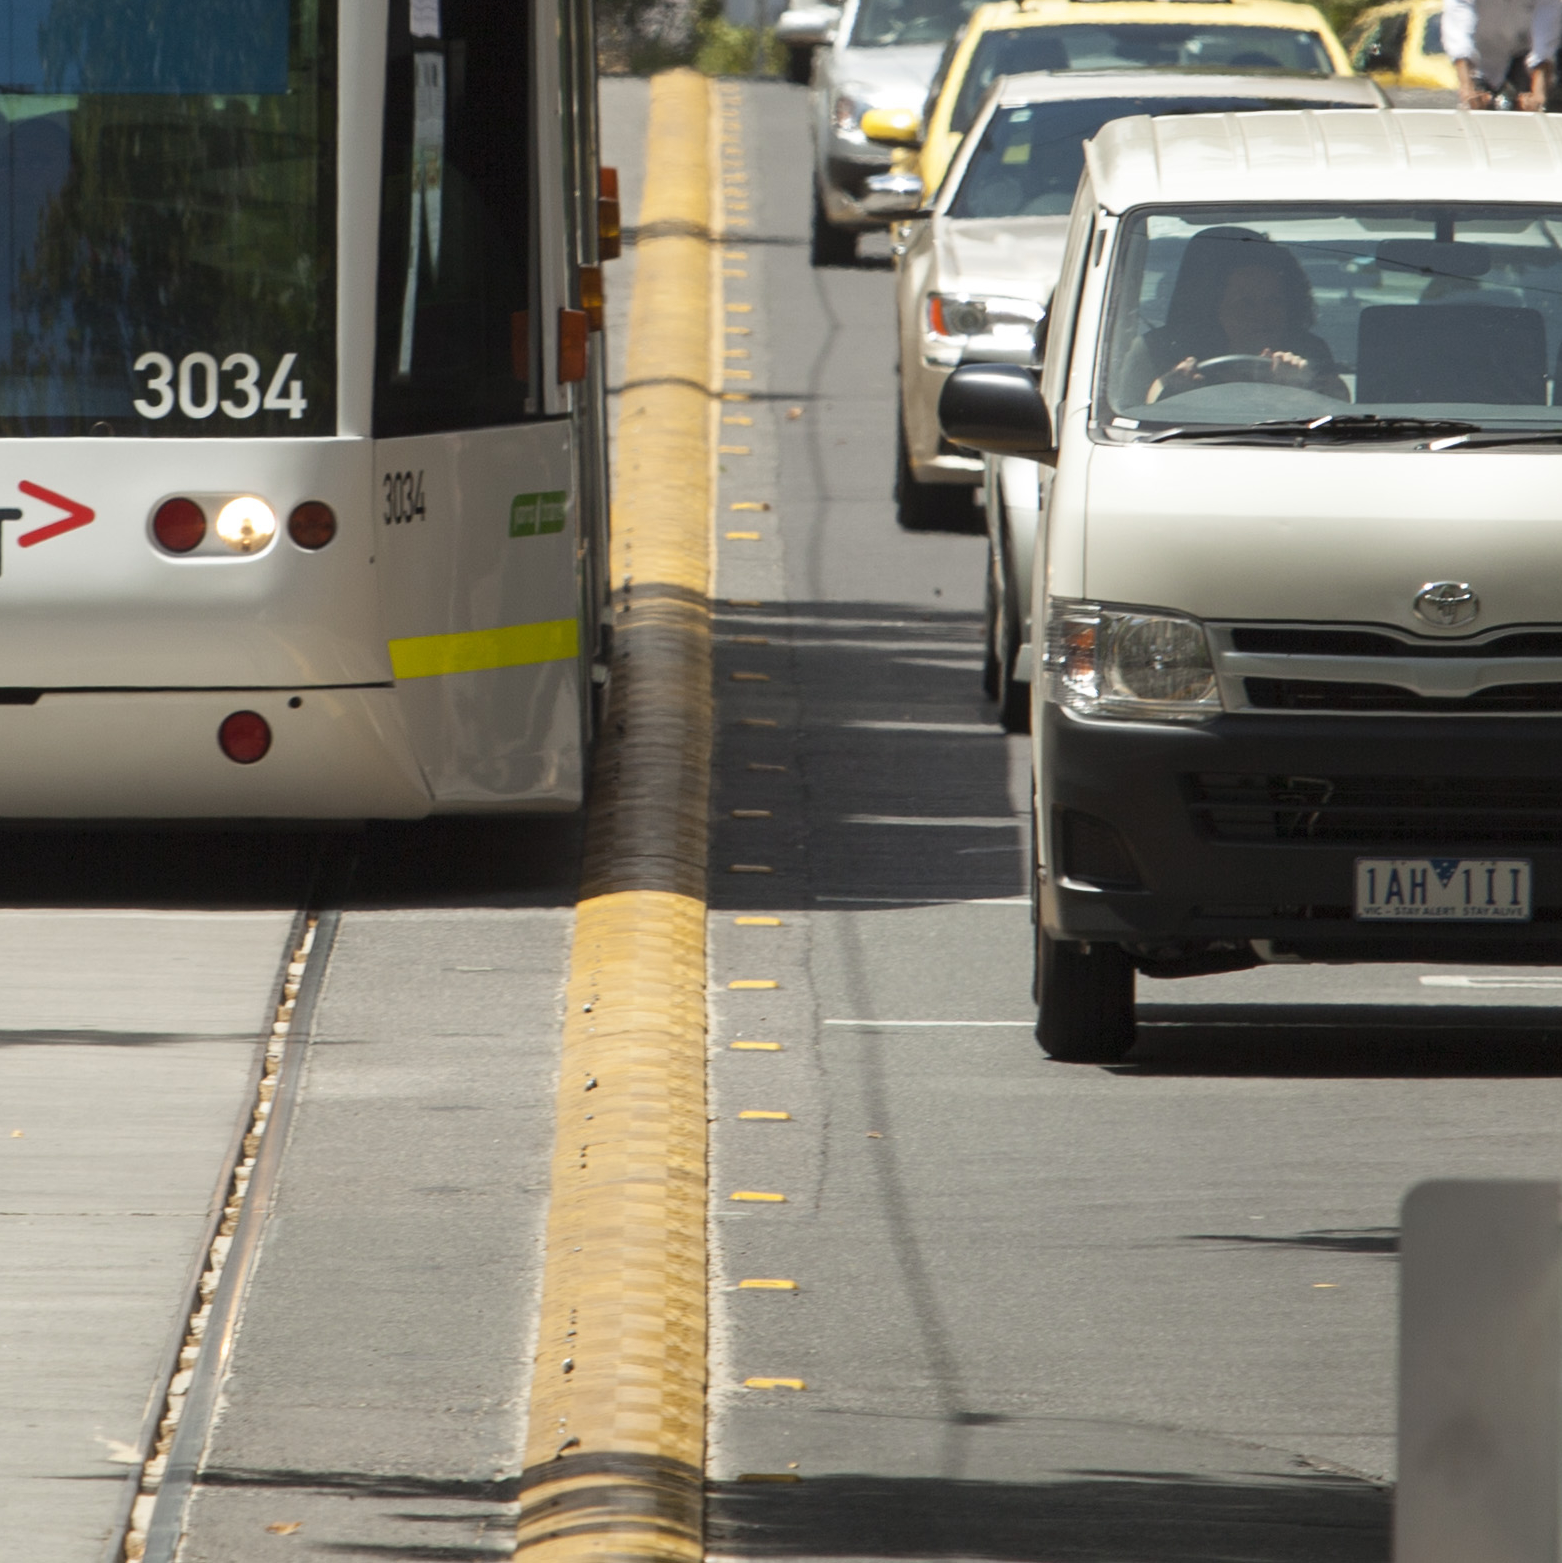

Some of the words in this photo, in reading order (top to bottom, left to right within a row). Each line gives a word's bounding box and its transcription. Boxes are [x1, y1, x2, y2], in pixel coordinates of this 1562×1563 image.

[134, 352, 307, 420] 3034
[383, 470, 425, 524] 3034
[1367, 868, 1427, 905] 1AH
[1394, 907, 1421, 915] STAY
[1423, 907, 1456, 915] ALERT
[1463, 907, 1488, 915] STAY
[1491, 907, 1522, 915] ALIVE
